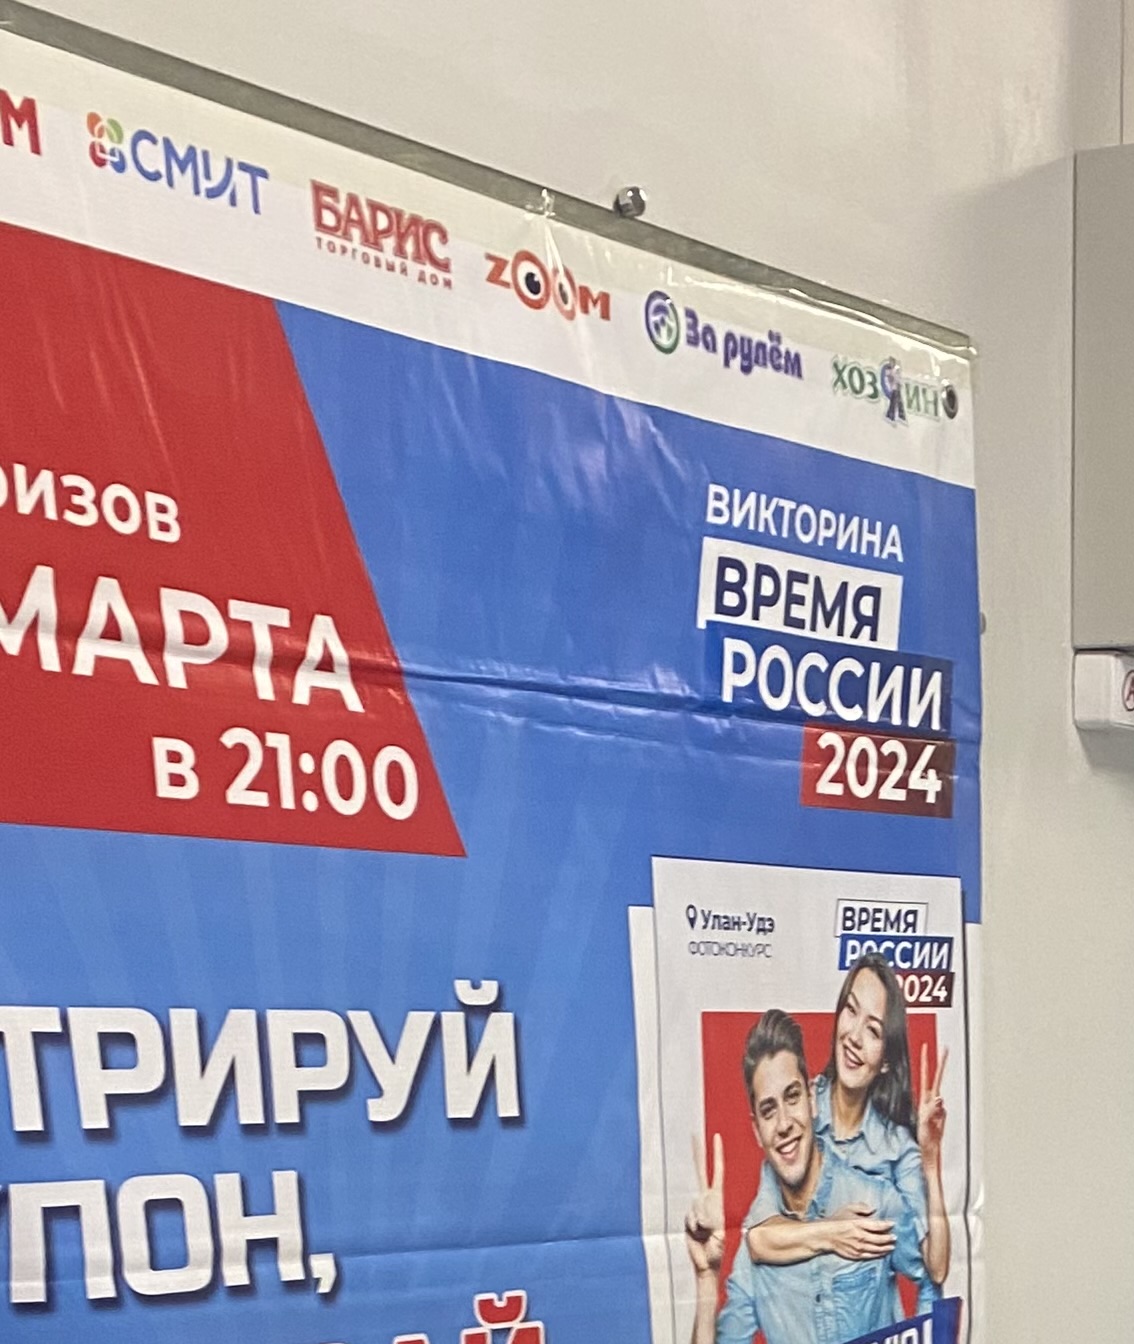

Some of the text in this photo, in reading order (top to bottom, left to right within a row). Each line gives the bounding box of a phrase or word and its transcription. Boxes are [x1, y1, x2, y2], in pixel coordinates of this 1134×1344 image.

[311, 179, 452, 274] БАРИС
[315, 236, 453, 290] ТОРГОВЫЙ ДОМ
[684, 307, 803, 380] За рулём
[705, 483, 903, 562] ВИКТОРИНА
[714, 556, 882, 641] ВРЕМЯ
[721, 638, 944, 730] РОССИИ
[219, 726, 419, 820] 21:00
[815, 732, 943, 804] 2024
[688, 940, 773, 959] ФОТОКОНКУРС
[700, 908, 776, 934] Улан-Удэ
[842, 906, 918, 933] ВРЕМЯ
[0, 979, 521, 1132] ТРИРУЙ
